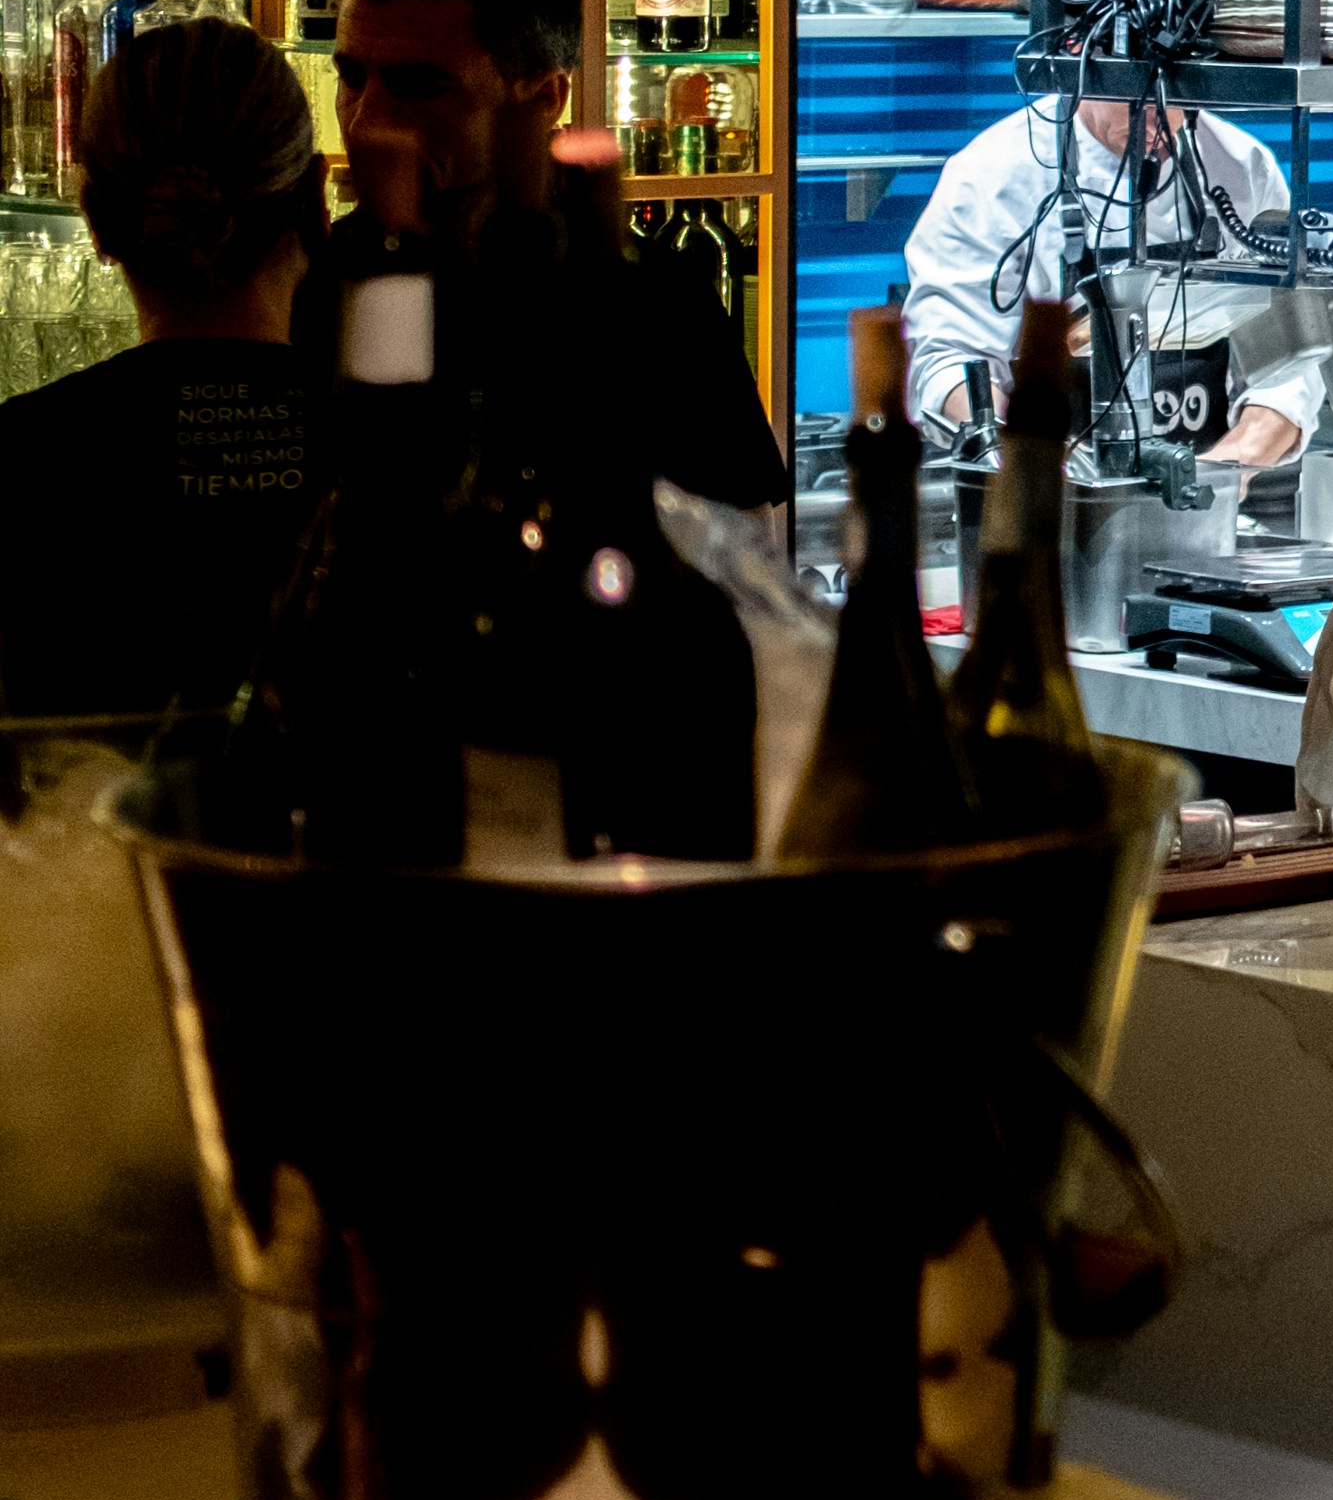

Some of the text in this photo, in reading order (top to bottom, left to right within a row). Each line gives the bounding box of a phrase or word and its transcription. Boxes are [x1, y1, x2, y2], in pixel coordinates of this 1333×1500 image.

[179, 383, 250, 401] SIGUE
[177, 404, 290, 424] NORMAS
[221, 445, 305, 467] MISMO
[176, 468, 304, 497] TIEMPO
